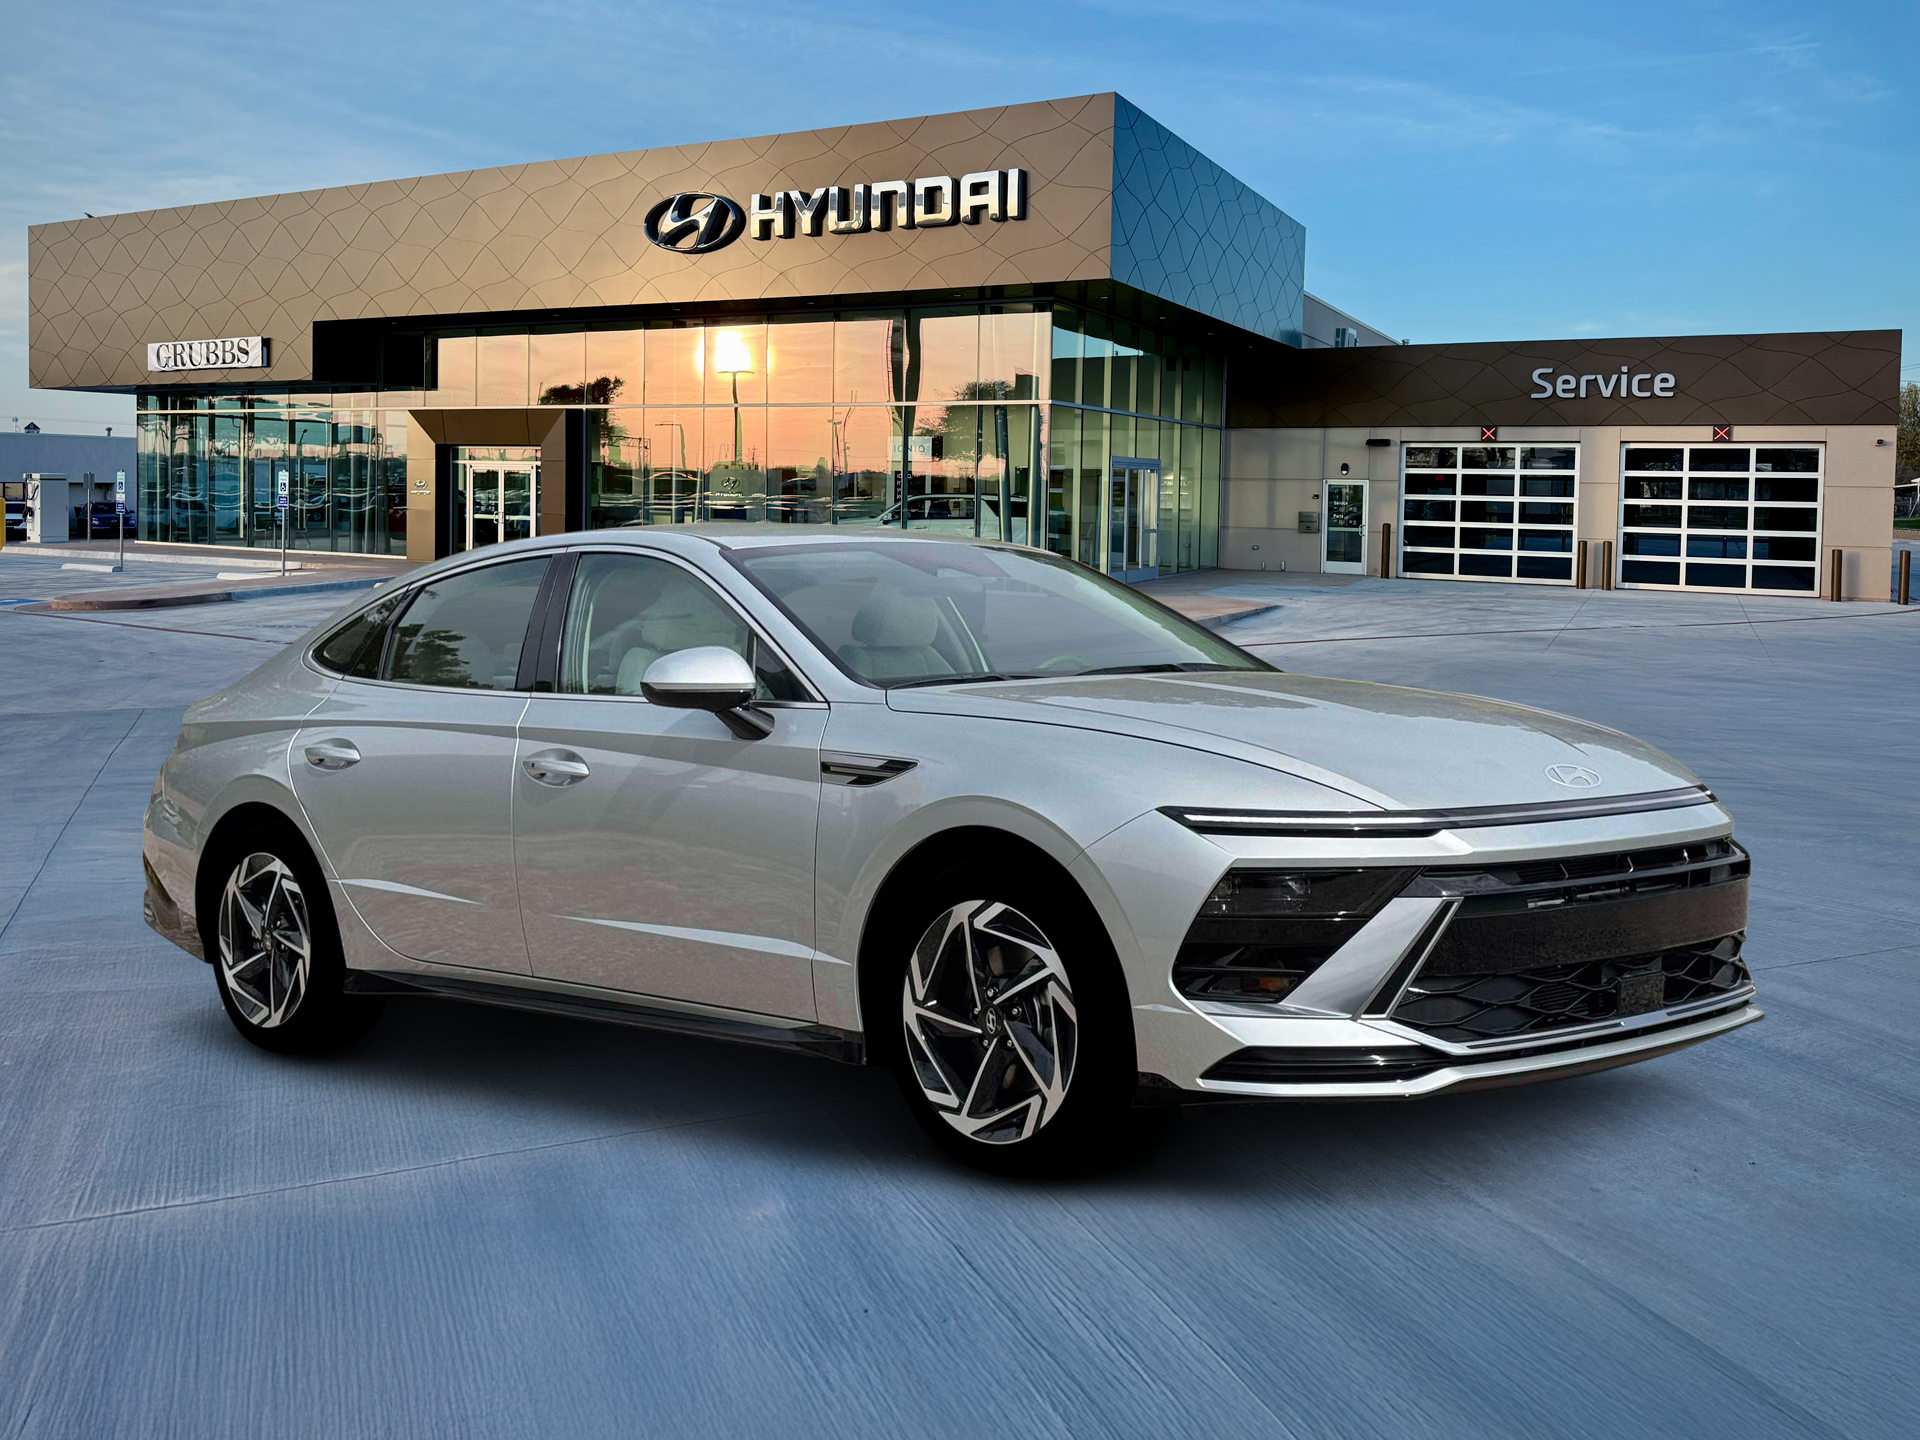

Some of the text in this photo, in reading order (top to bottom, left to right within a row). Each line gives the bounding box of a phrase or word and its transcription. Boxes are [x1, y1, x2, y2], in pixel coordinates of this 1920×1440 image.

[751, 168, 1024, 240] HYUNDAI
[156, 338, 250, 368] GRUBBS
[1530, 365, 1676, 399] Service
